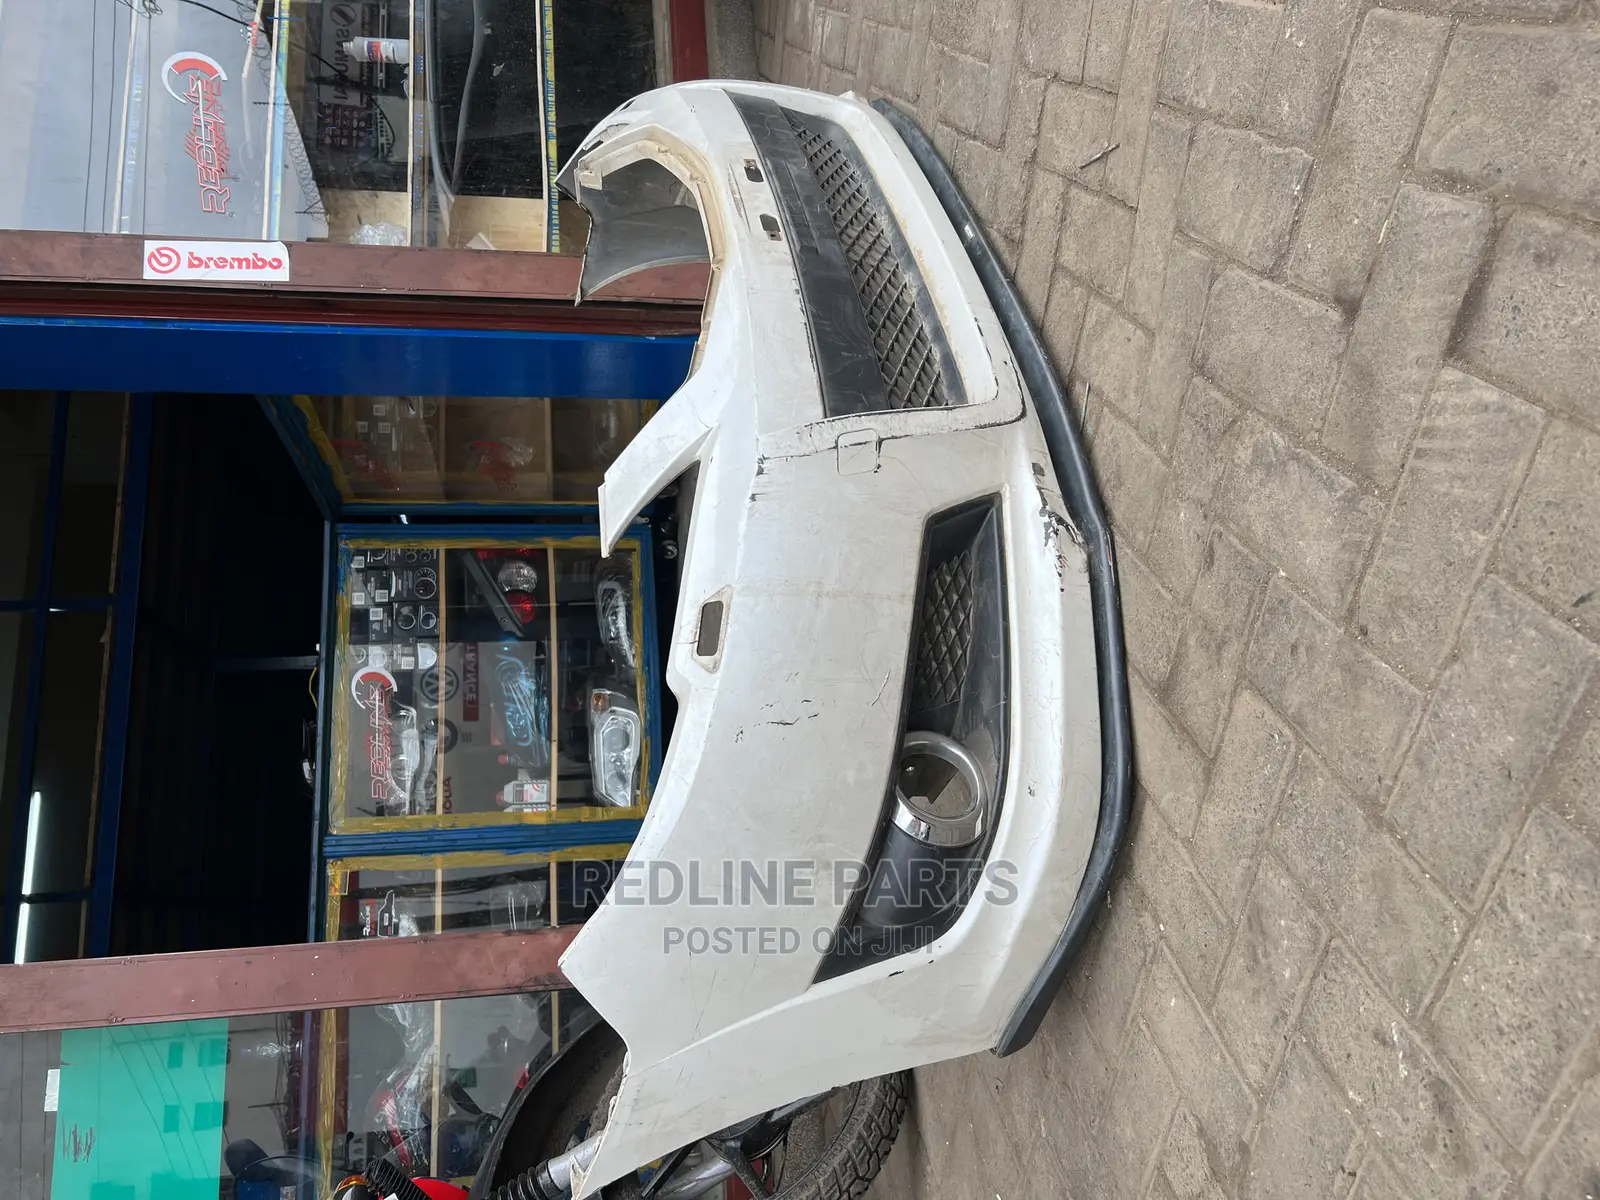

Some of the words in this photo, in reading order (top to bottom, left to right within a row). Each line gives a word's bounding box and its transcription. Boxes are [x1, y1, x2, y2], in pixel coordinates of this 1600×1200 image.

[183, 74, 231, 213] REDLINE
[188, 251, 283, 270] brembo
[365, 684, 393, 800] REDLINE
